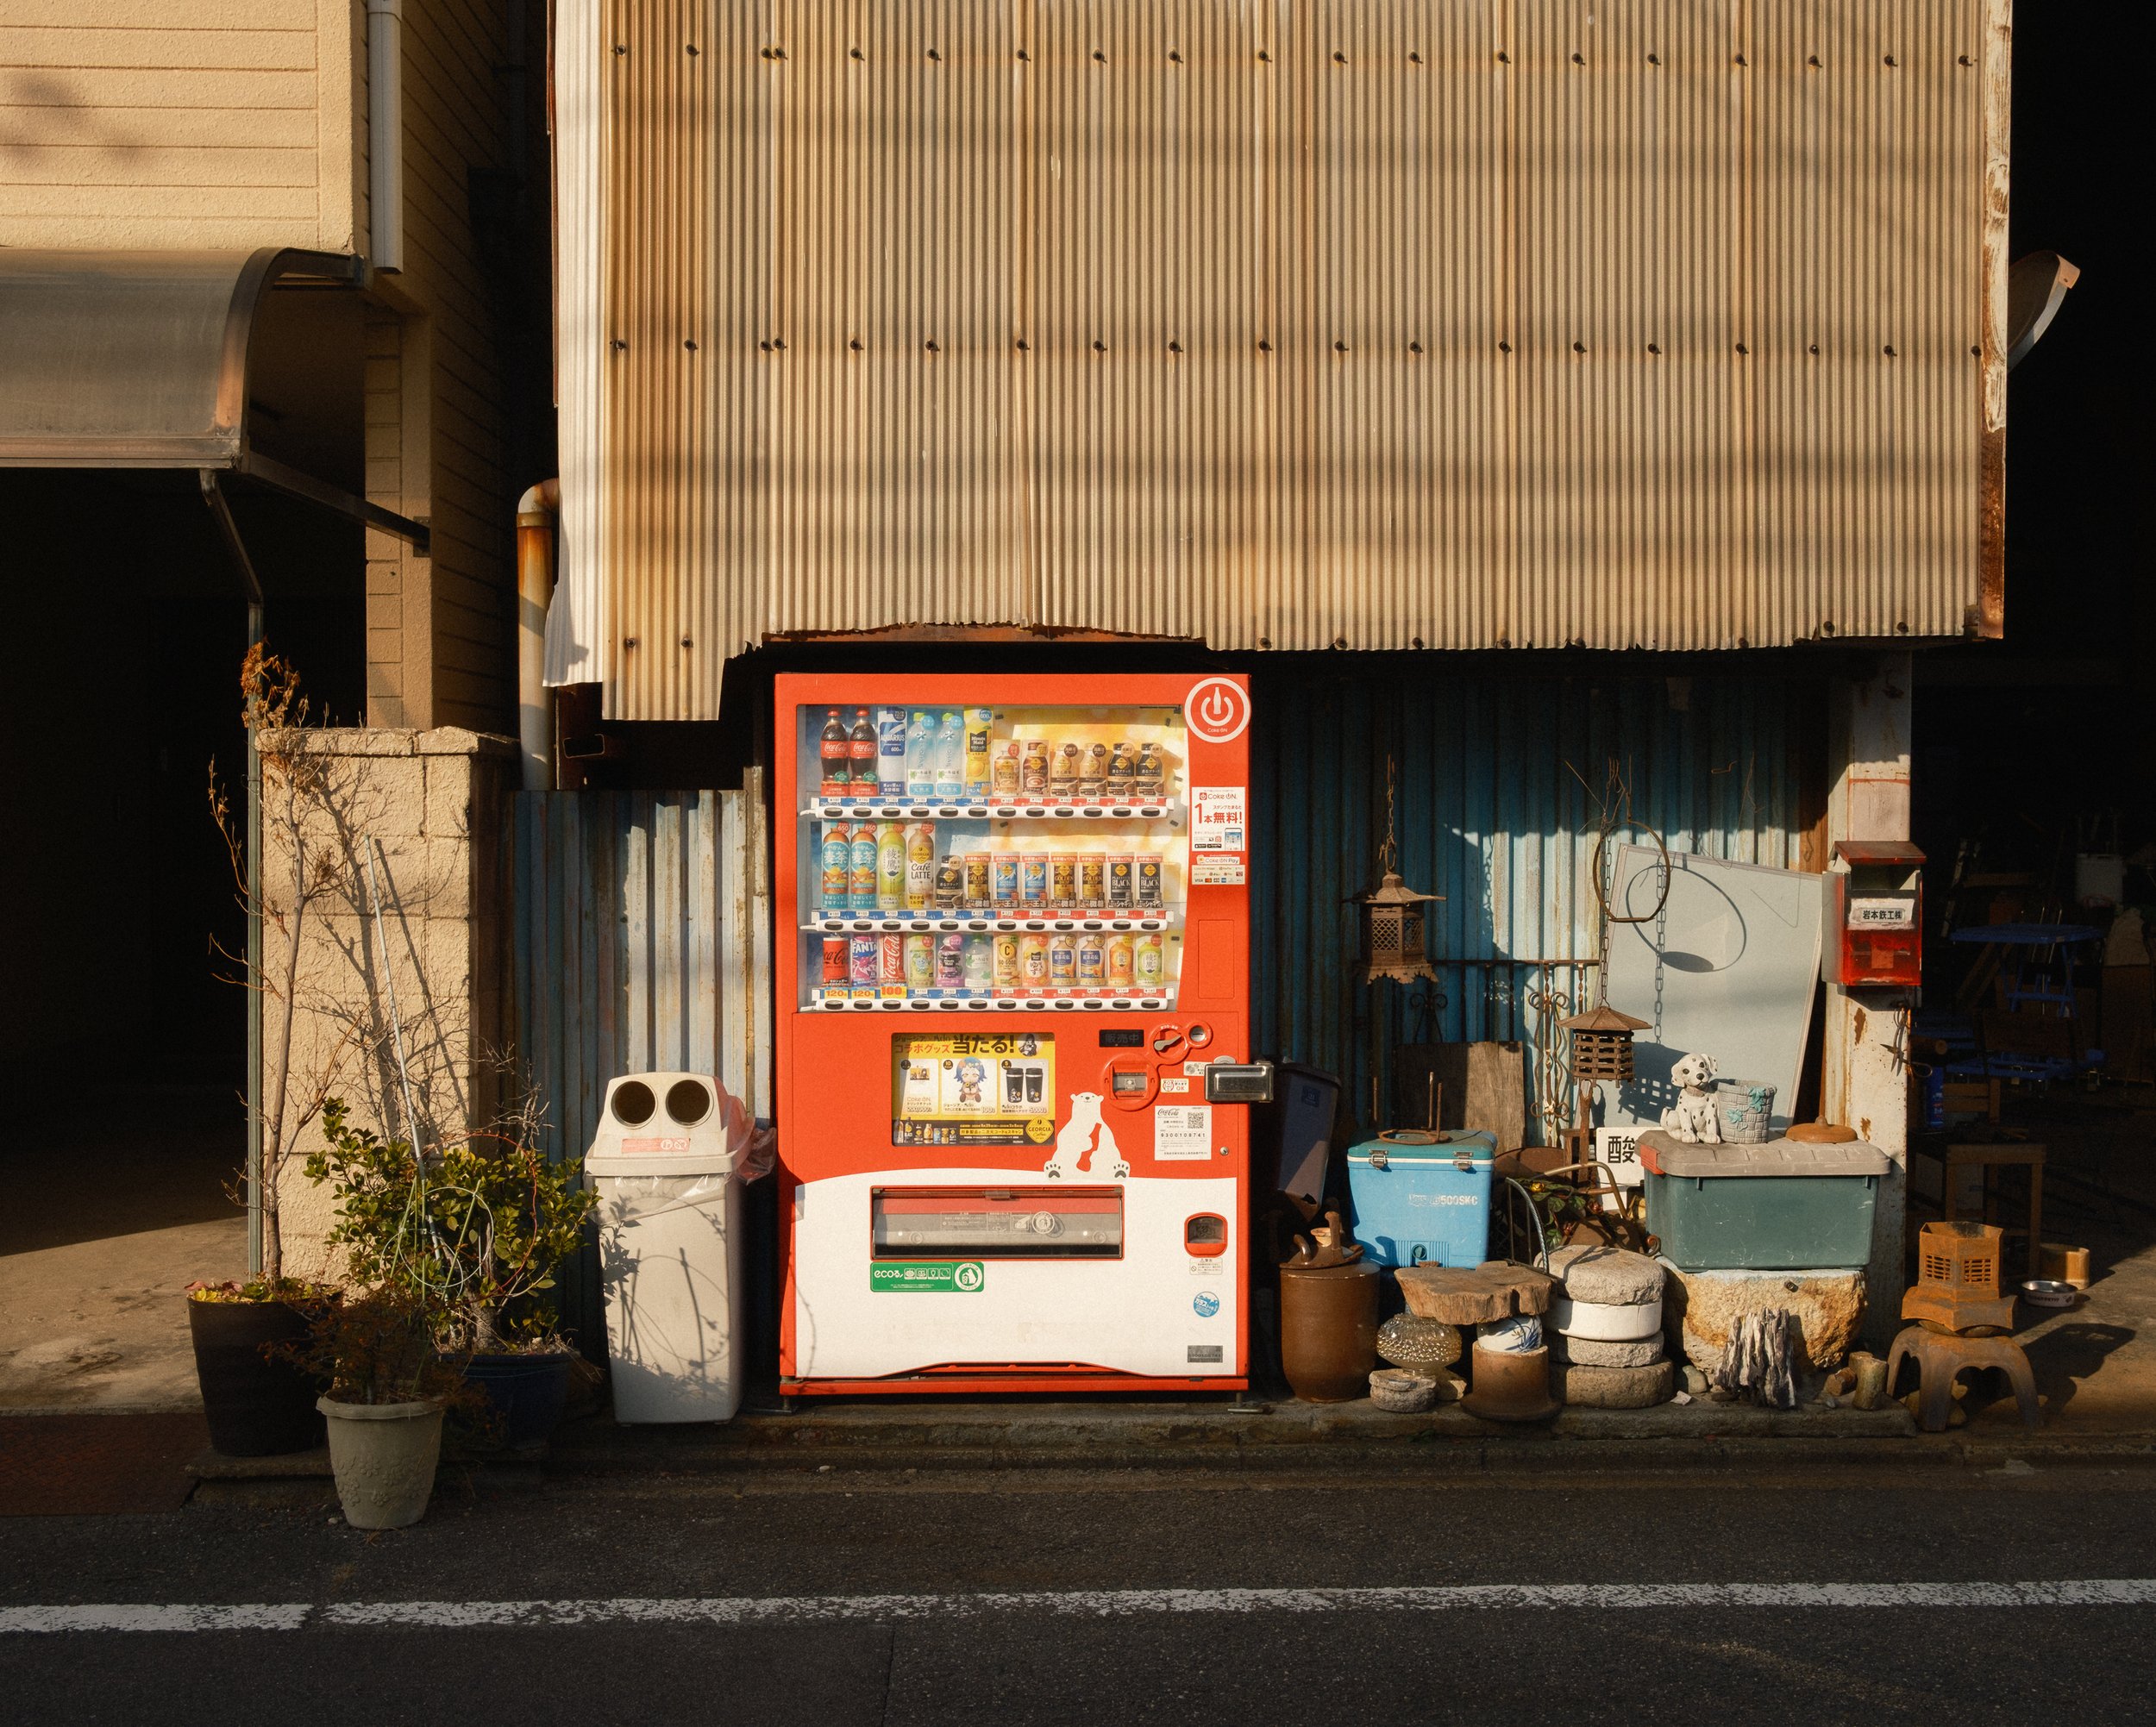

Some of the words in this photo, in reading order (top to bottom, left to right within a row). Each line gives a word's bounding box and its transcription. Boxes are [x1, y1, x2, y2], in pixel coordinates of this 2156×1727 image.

[824, 850, 848, 864] 麦茶
[851, 850, 876, 864] 麦茶
[911, 871, 931, 879] LATTE
[884, 933, 900, 979] Coca-Cola
[894, 1043, 950, 1054] コラボグッズ
[952, 1035, 1015, 1054] 当たる!
[1608, 1135, 1635, 1164] 酸
